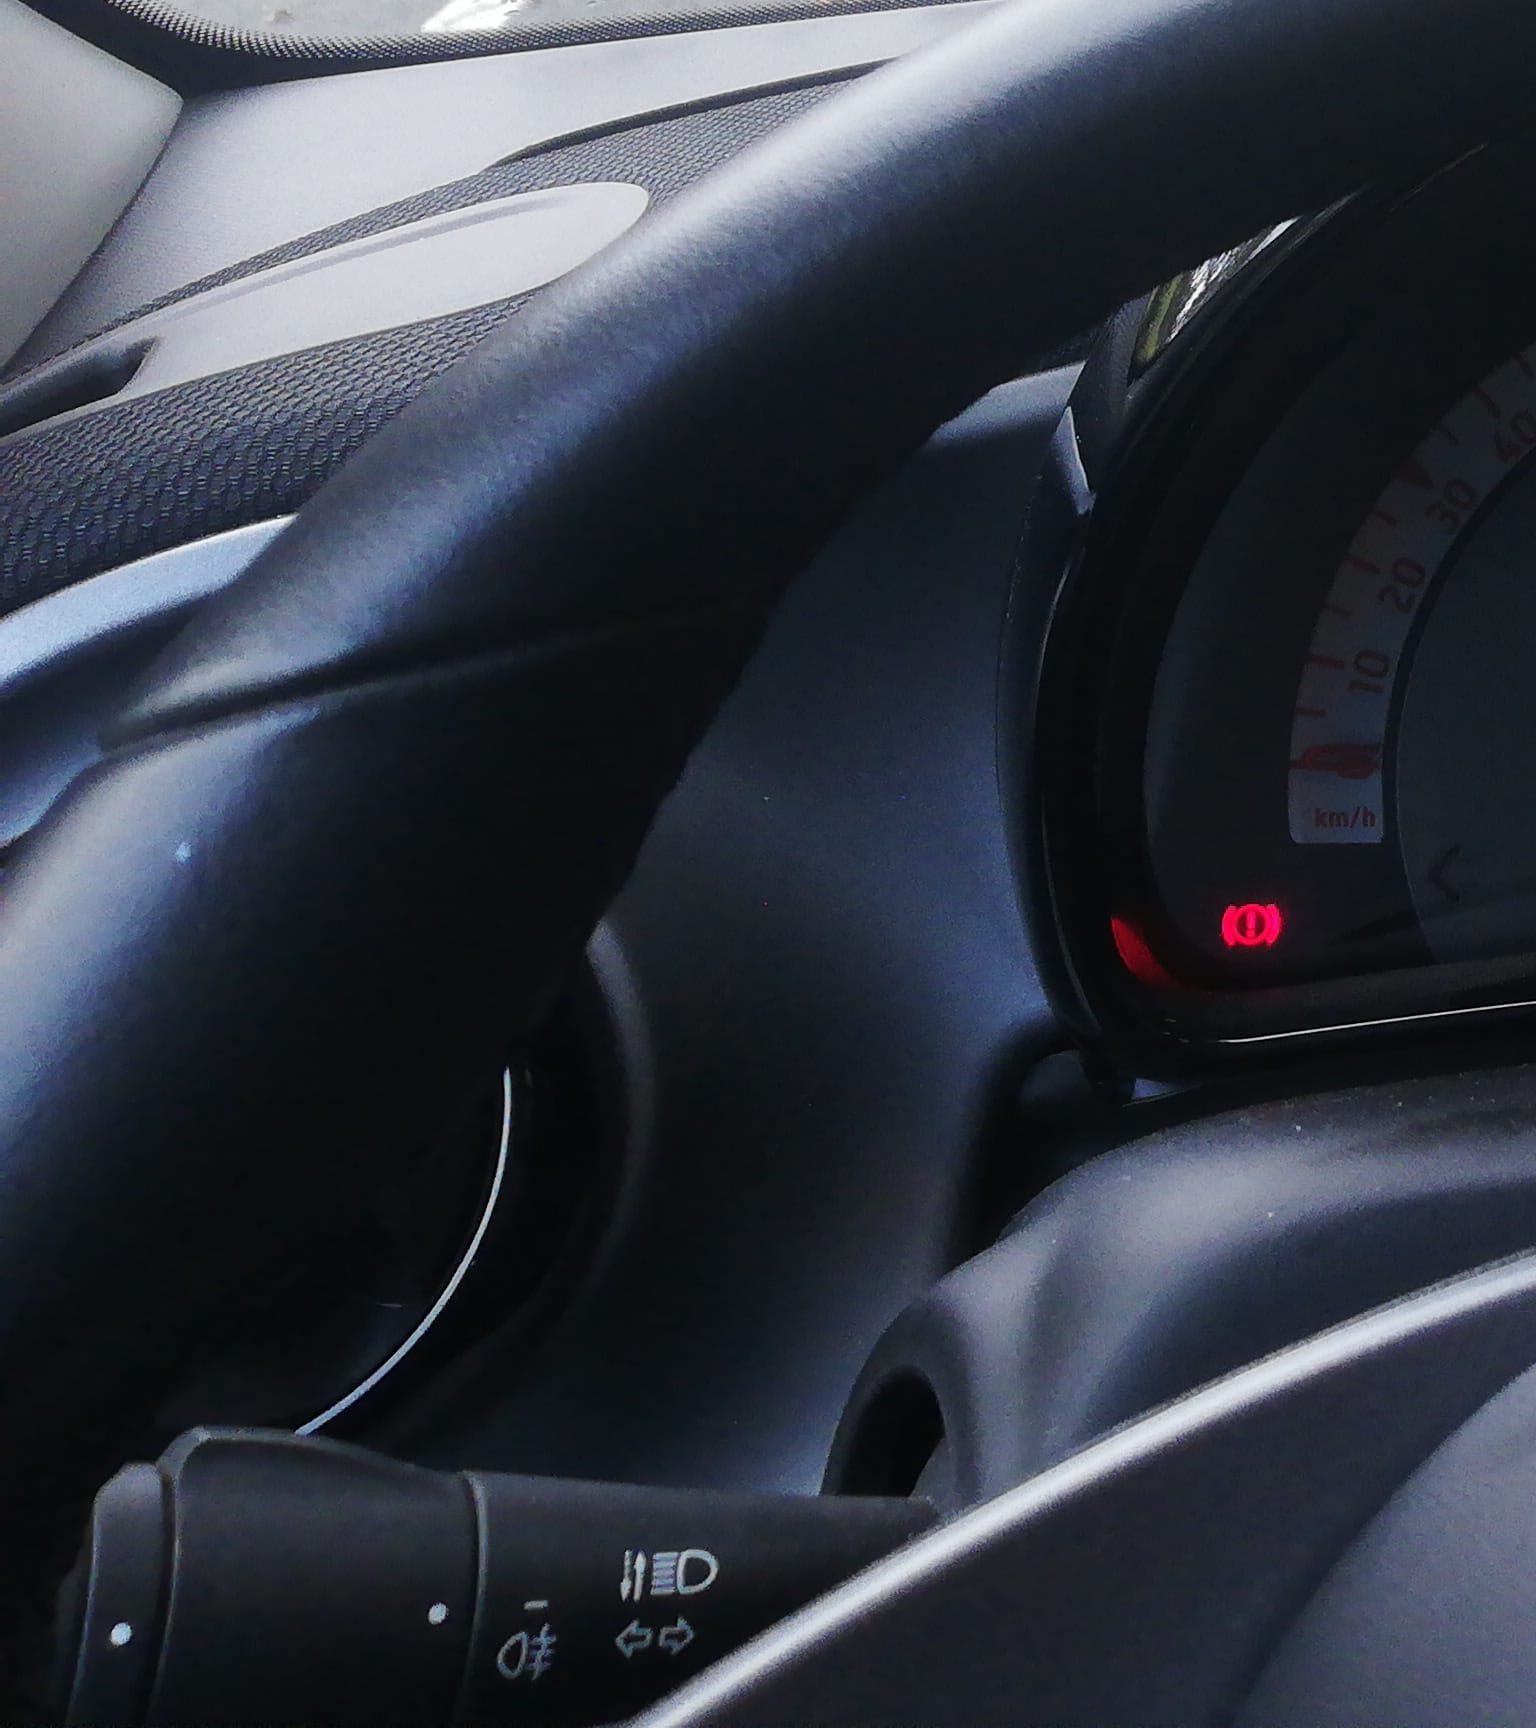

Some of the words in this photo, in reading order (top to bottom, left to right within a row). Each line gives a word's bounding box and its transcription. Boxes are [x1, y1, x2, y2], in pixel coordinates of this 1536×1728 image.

[1424, 478, 1480, 536] 30
[1379, 556, 1427, 614] 20
[1346, 648, 1391, 695] 10
[1313, 805, 1377, 828] km/h
